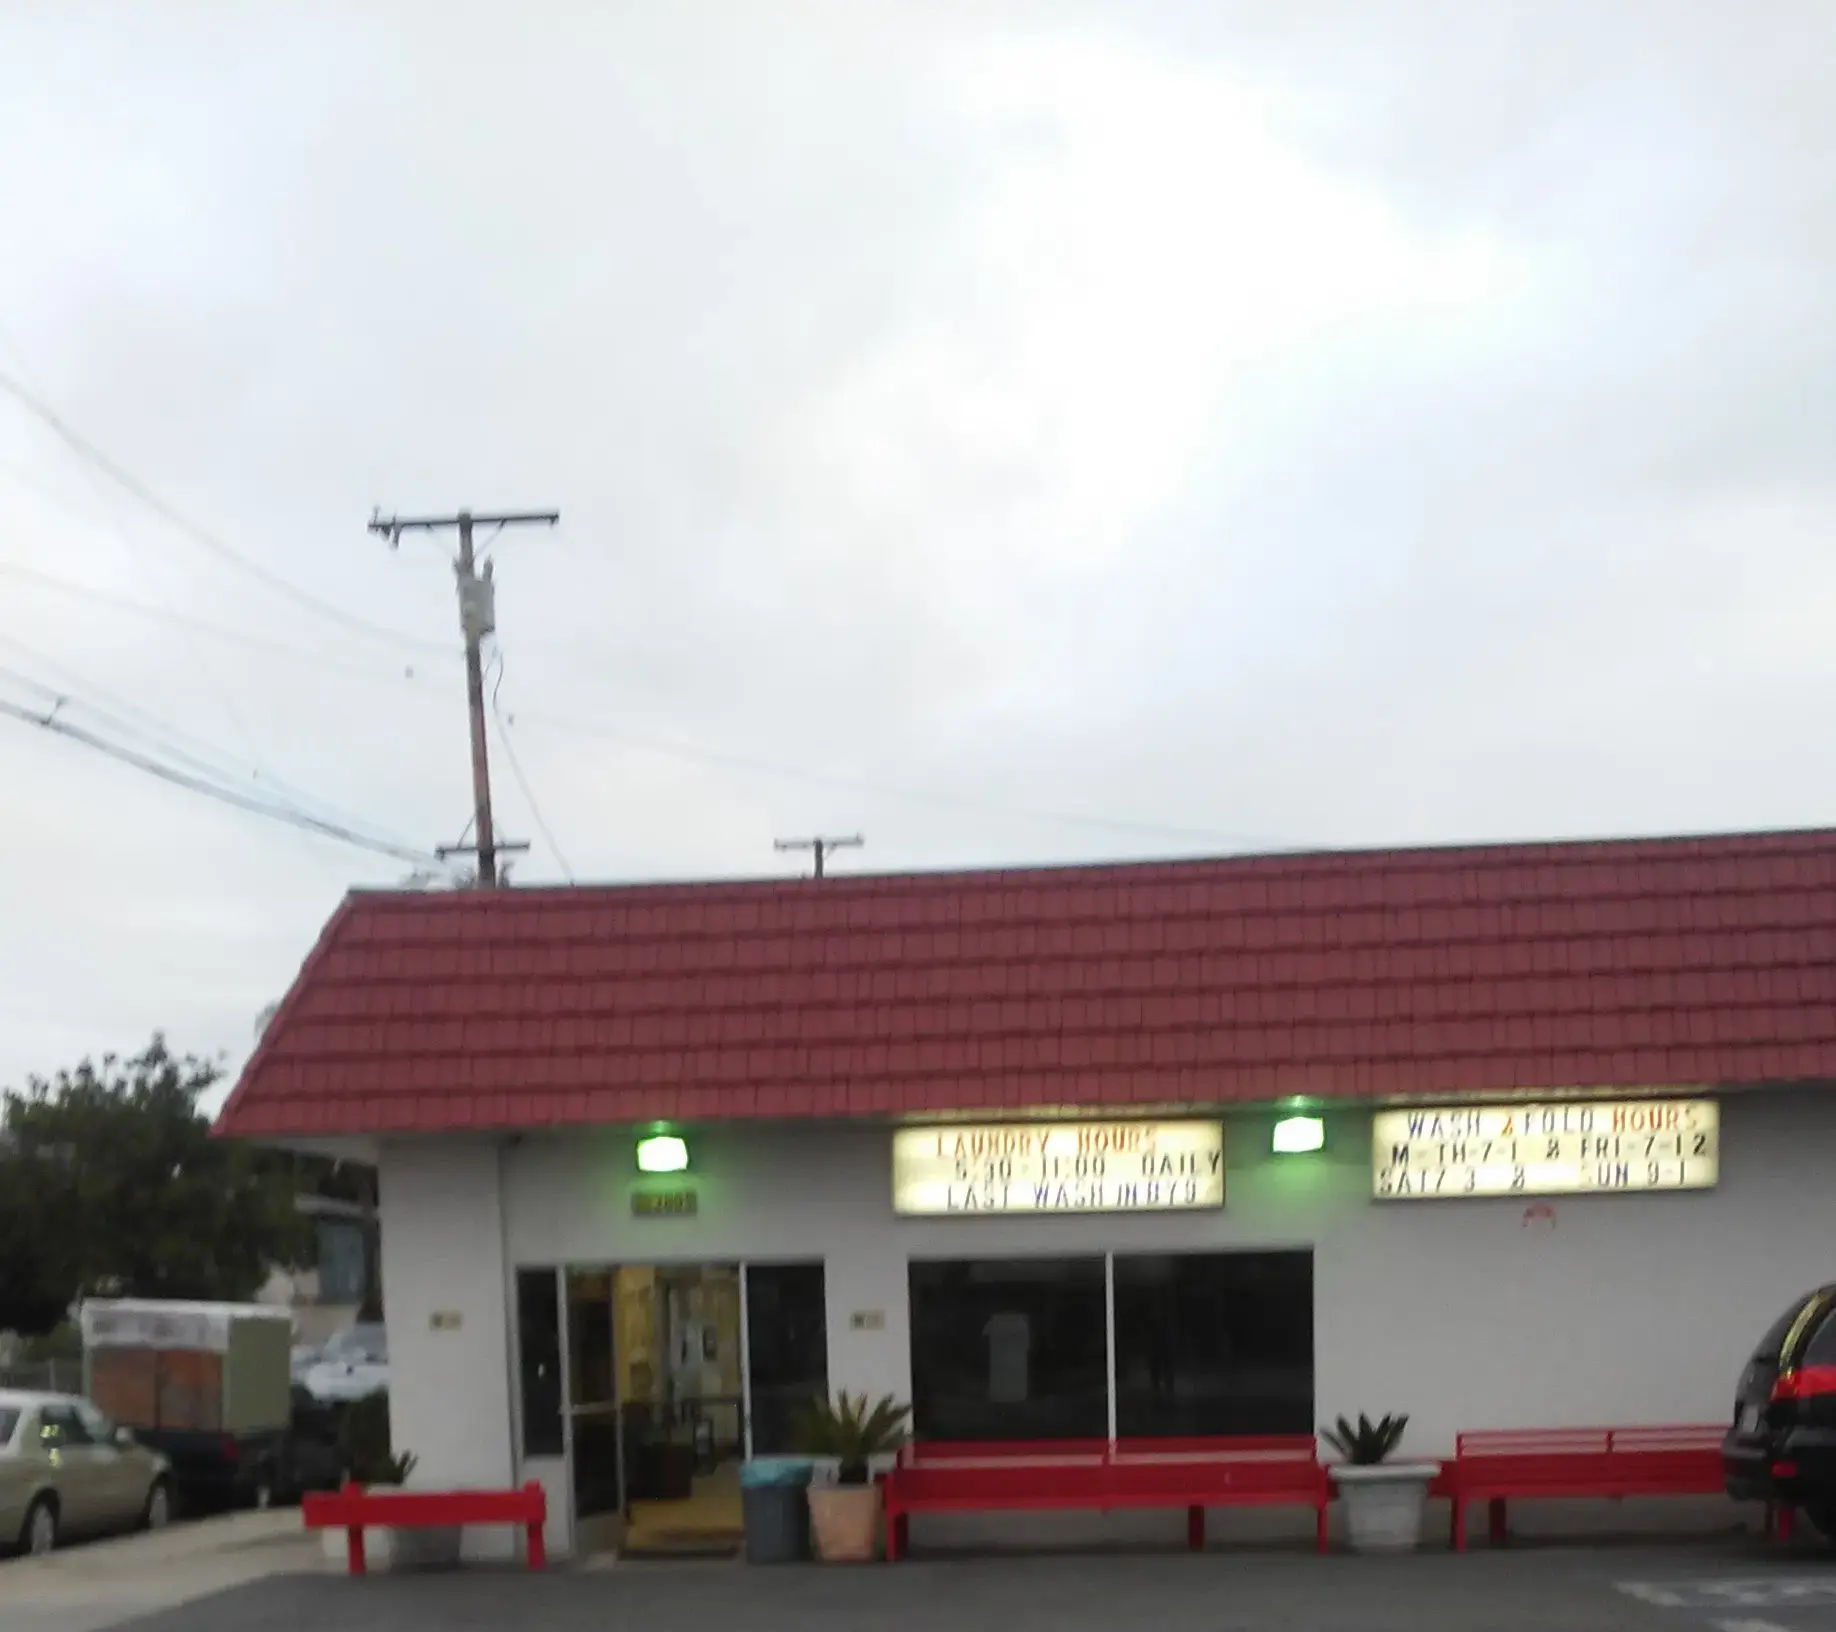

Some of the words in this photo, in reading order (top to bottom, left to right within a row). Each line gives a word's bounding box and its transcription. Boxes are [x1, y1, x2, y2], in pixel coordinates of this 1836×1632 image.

[1407, 1109, 1481, 1139] WASH
[1524, 1107, 1595, 1136] FOLD
[1612, 1103, 1699, 1132] HOURS
[937, 1127, 1052, 1157] LAUNDRY
[1076, 1125, 1158, 1154] HOURS
[1141, 1152, 1222, 1181] DAILY
[1579, 1159, 1629, 1188] SUN
[947, 1182, 1009, 1210] LAST
[1033, 1180, 1103, 1208] WASH
